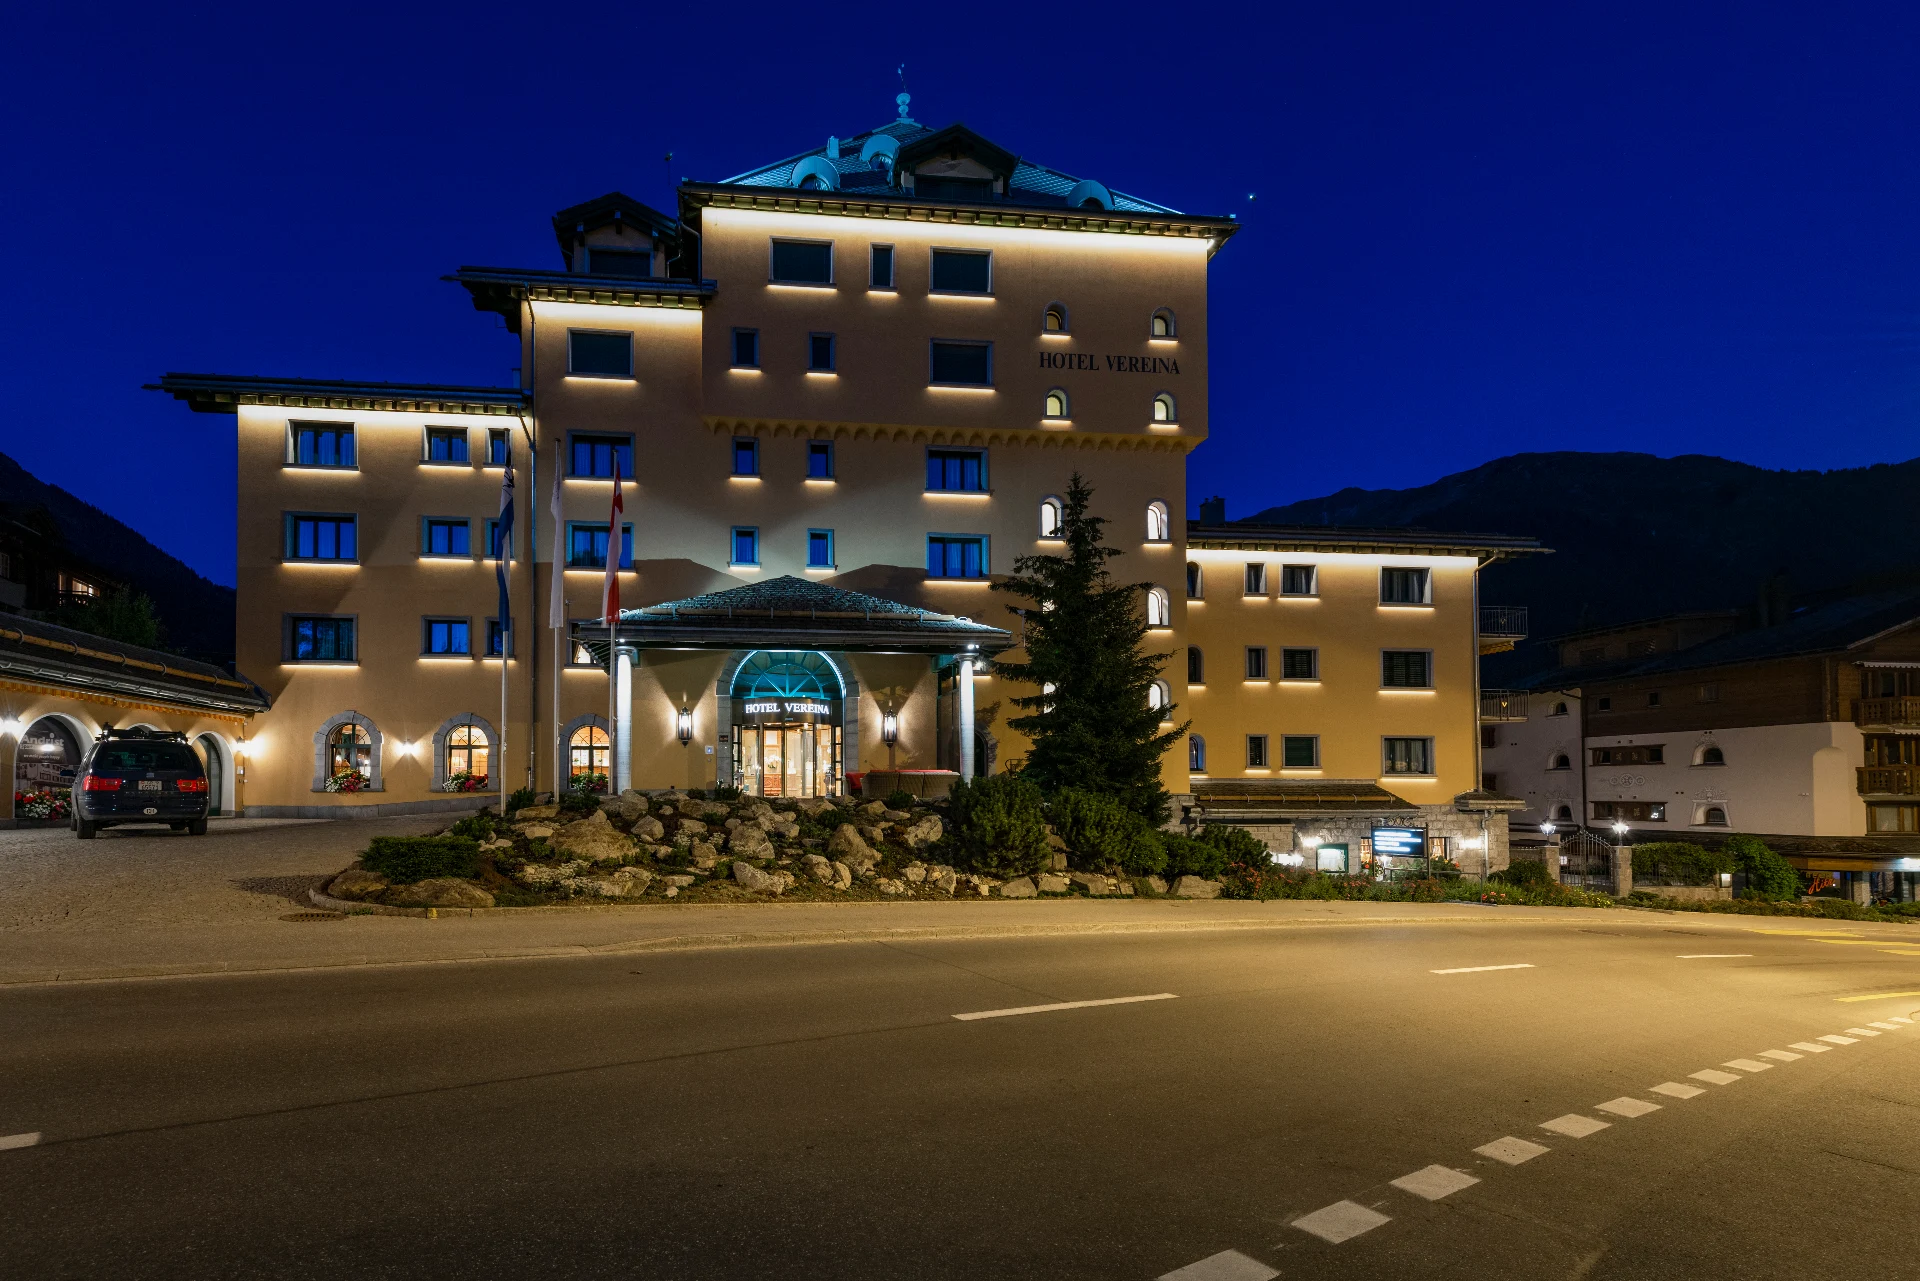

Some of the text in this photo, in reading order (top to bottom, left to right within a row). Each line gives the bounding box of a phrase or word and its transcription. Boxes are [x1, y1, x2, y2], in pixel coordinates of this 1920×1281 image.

[1039, 352, 1180, 374] HOTEL VEREINA
[745, 703, 830, 714] HOTEL VEREINA
[20, 732, 65, 747] Andrist
